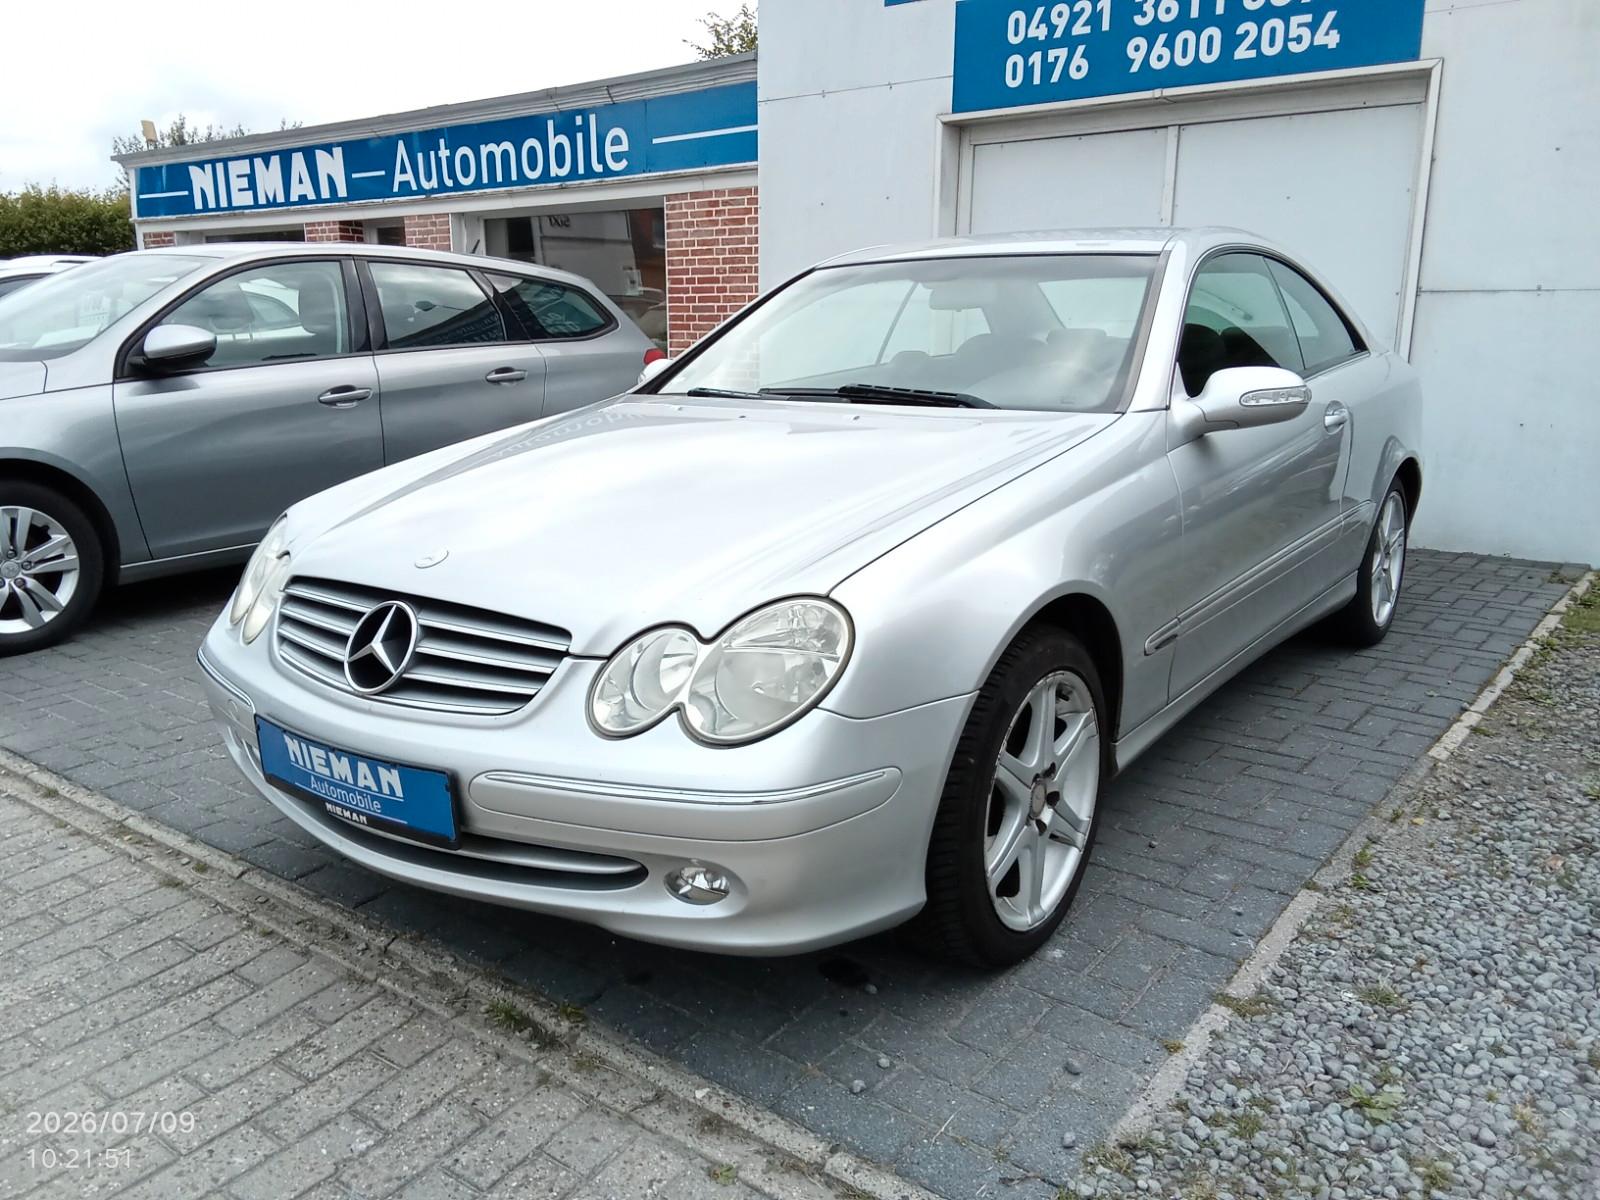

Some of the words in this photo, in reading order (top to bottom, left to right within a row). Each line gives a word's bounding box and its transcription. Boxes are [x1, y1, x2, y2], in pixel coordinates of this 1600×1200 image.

[1004, 45, 1089, 88] 0176
[1126, 26, 1222, 73] 9600
[1233, 10, 1341, 60] 2054
[1007, 0, 1111, 45] 04921
[188, 147, 347, 210] NIEMAN
[392, 113, 630, 193] Automobile
[283, 734, 404, 797] NIEMAN
[310, 775, 382, 813] Automobile
[325, 802, 368, 825] NIEMAN
